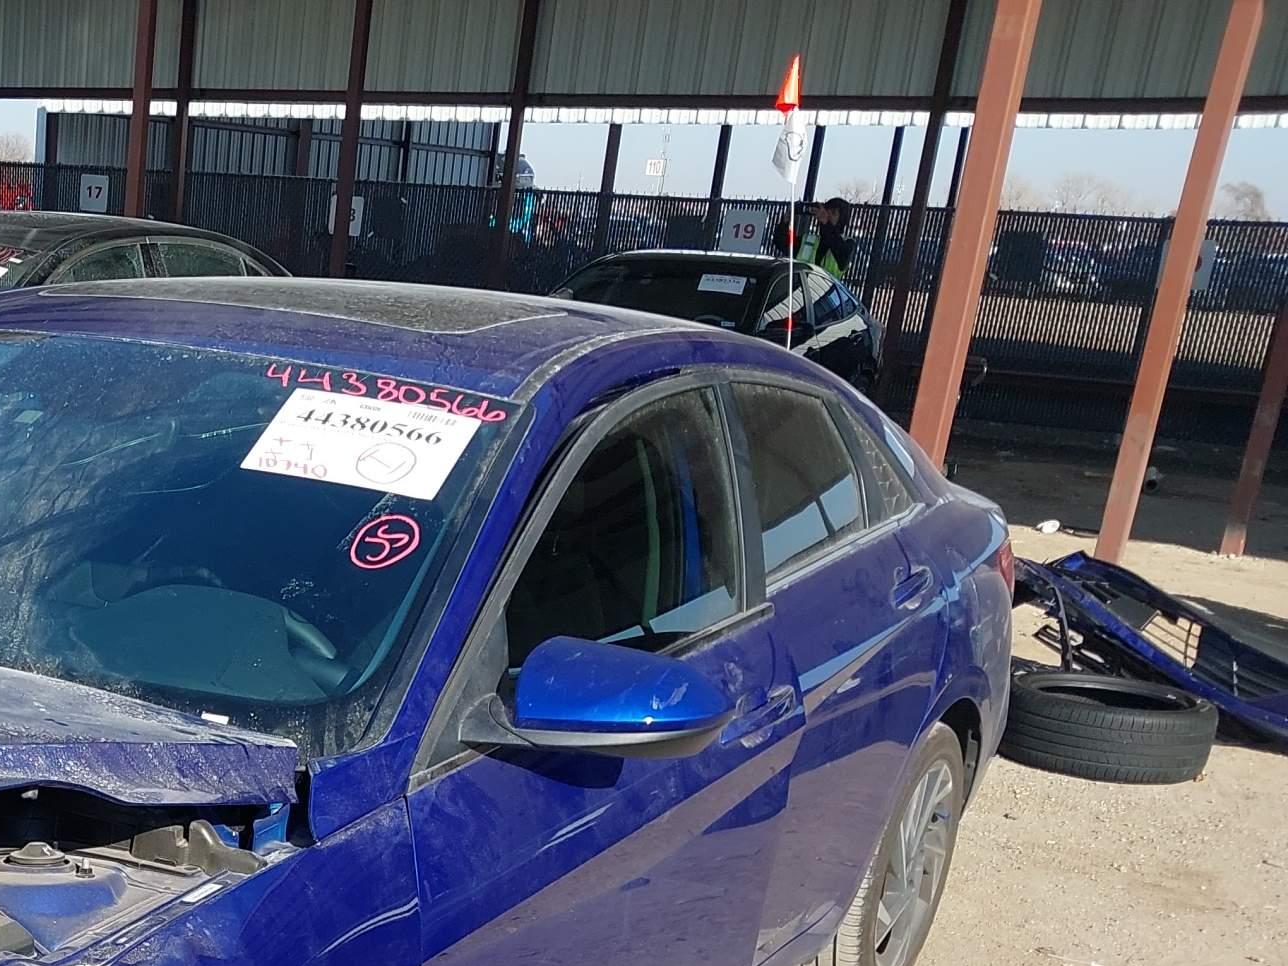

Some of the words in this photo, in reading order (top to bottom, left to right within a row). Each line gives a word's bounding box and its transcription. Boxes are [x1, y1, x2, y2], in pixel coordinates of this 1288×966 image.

[648, 160, 661, 174] 110
[86, 185, 103, 199] 17
[732, 223, 756, 240] 19
[266, 362, 507, 424] 44380566
[296, 408, 442, 446] 44380566
